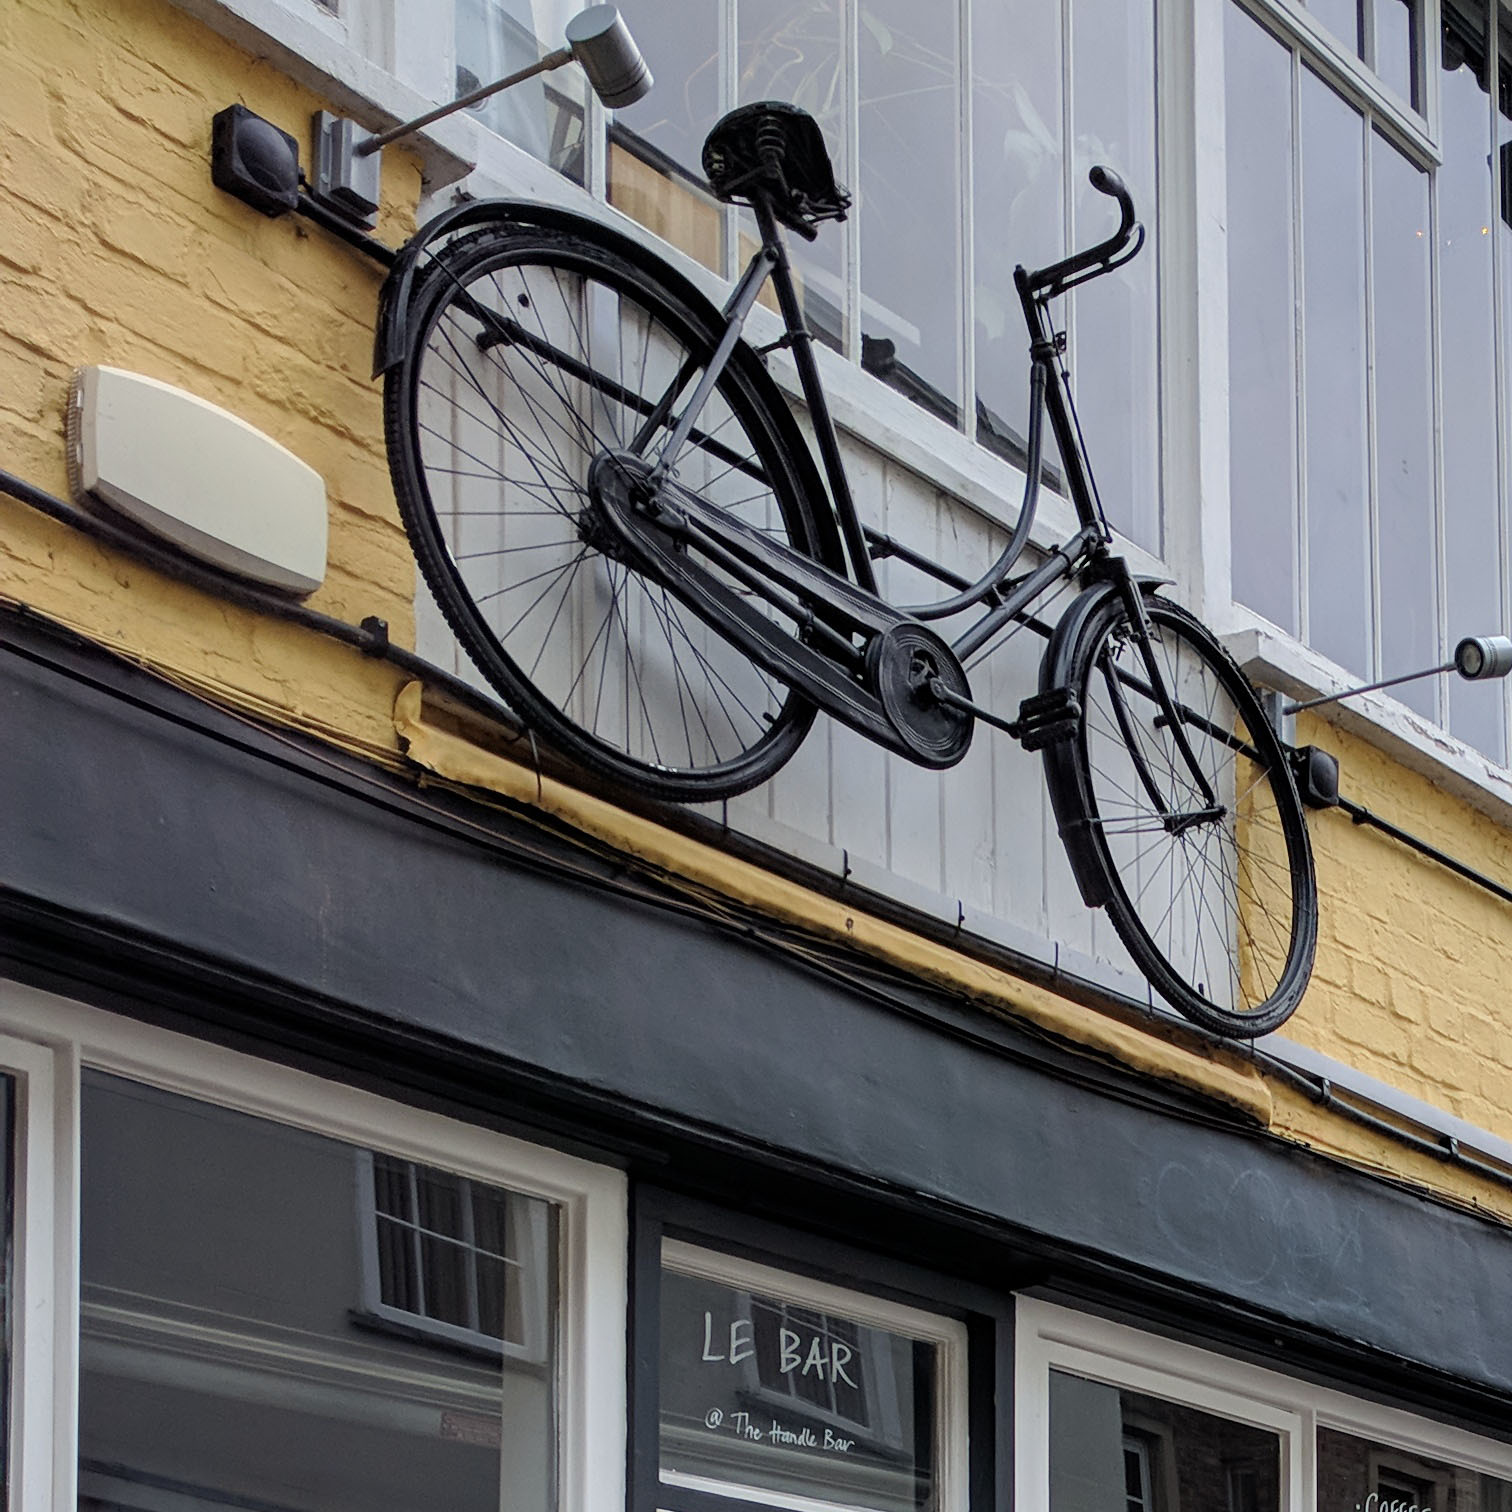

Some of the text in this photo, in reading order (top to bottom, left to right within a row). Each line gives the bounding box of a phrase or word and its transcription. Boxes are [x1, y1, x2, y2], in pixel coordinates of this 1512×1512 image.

[701, 1311, 859, 1389] LE BAR
[704, 1407, 856, 1453] @ The Handle Bar
